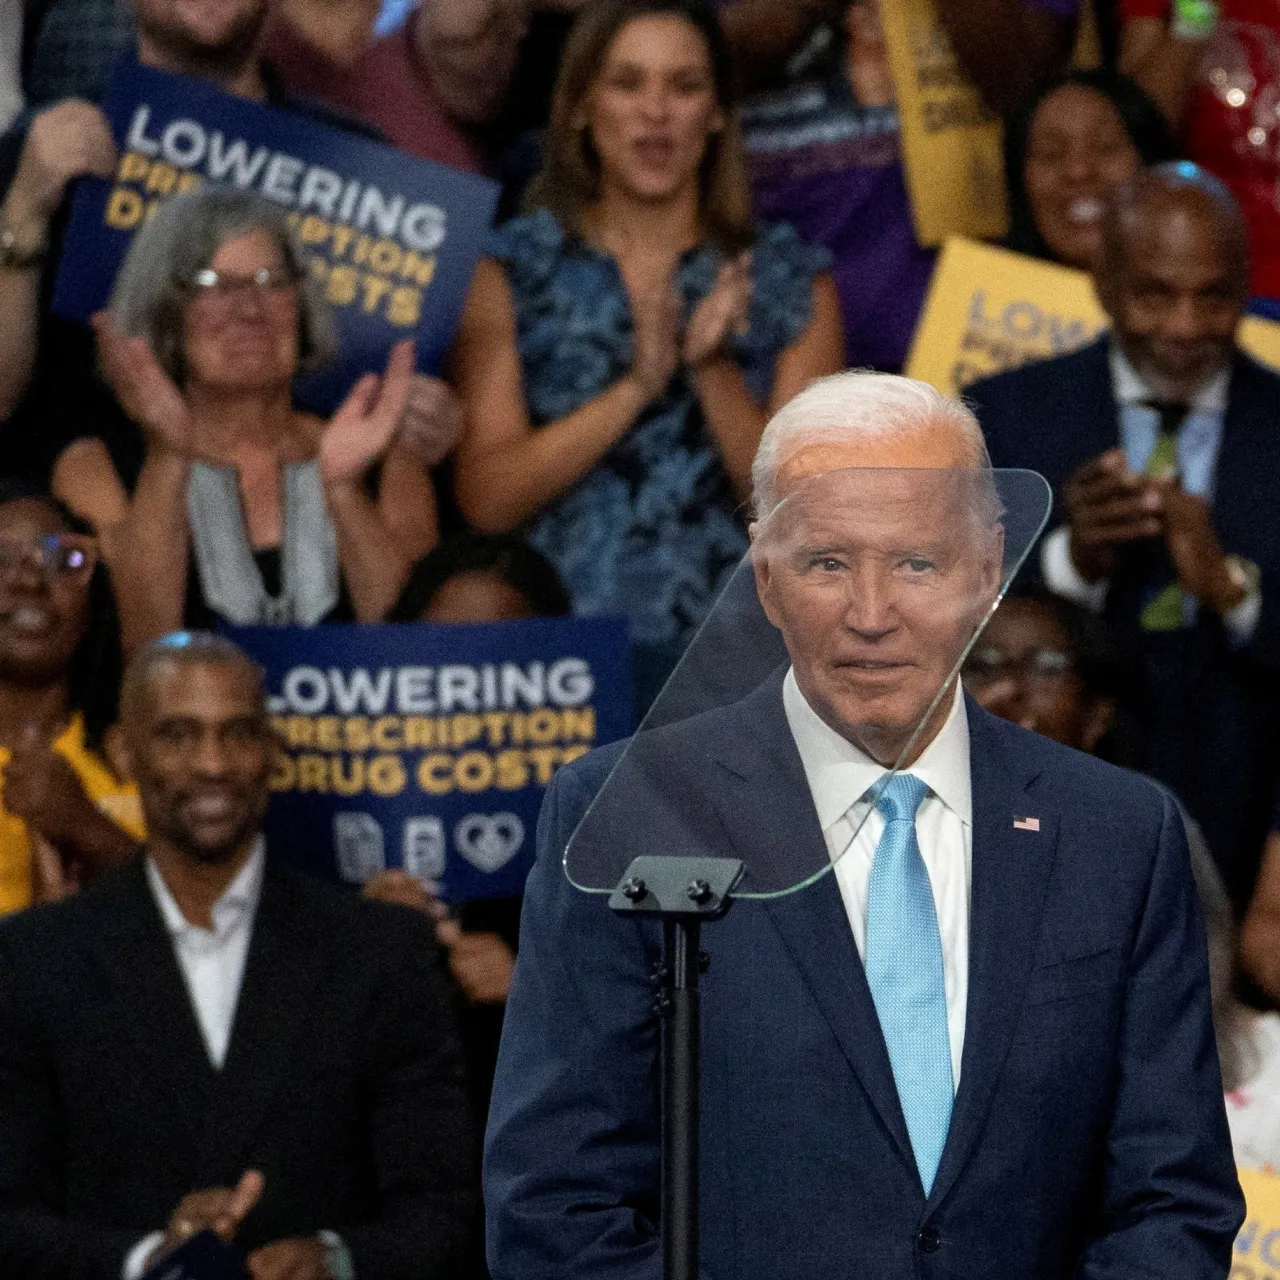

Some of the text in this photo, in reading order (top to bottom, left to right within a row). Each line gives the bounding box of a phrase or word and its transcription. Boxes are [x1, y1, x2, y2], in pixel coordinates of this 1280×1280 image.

[119, 152, 437, 288] PRPTION
[126, 104, 448, 252] LOWERING
[266, 656, 597, 717] OWERING
